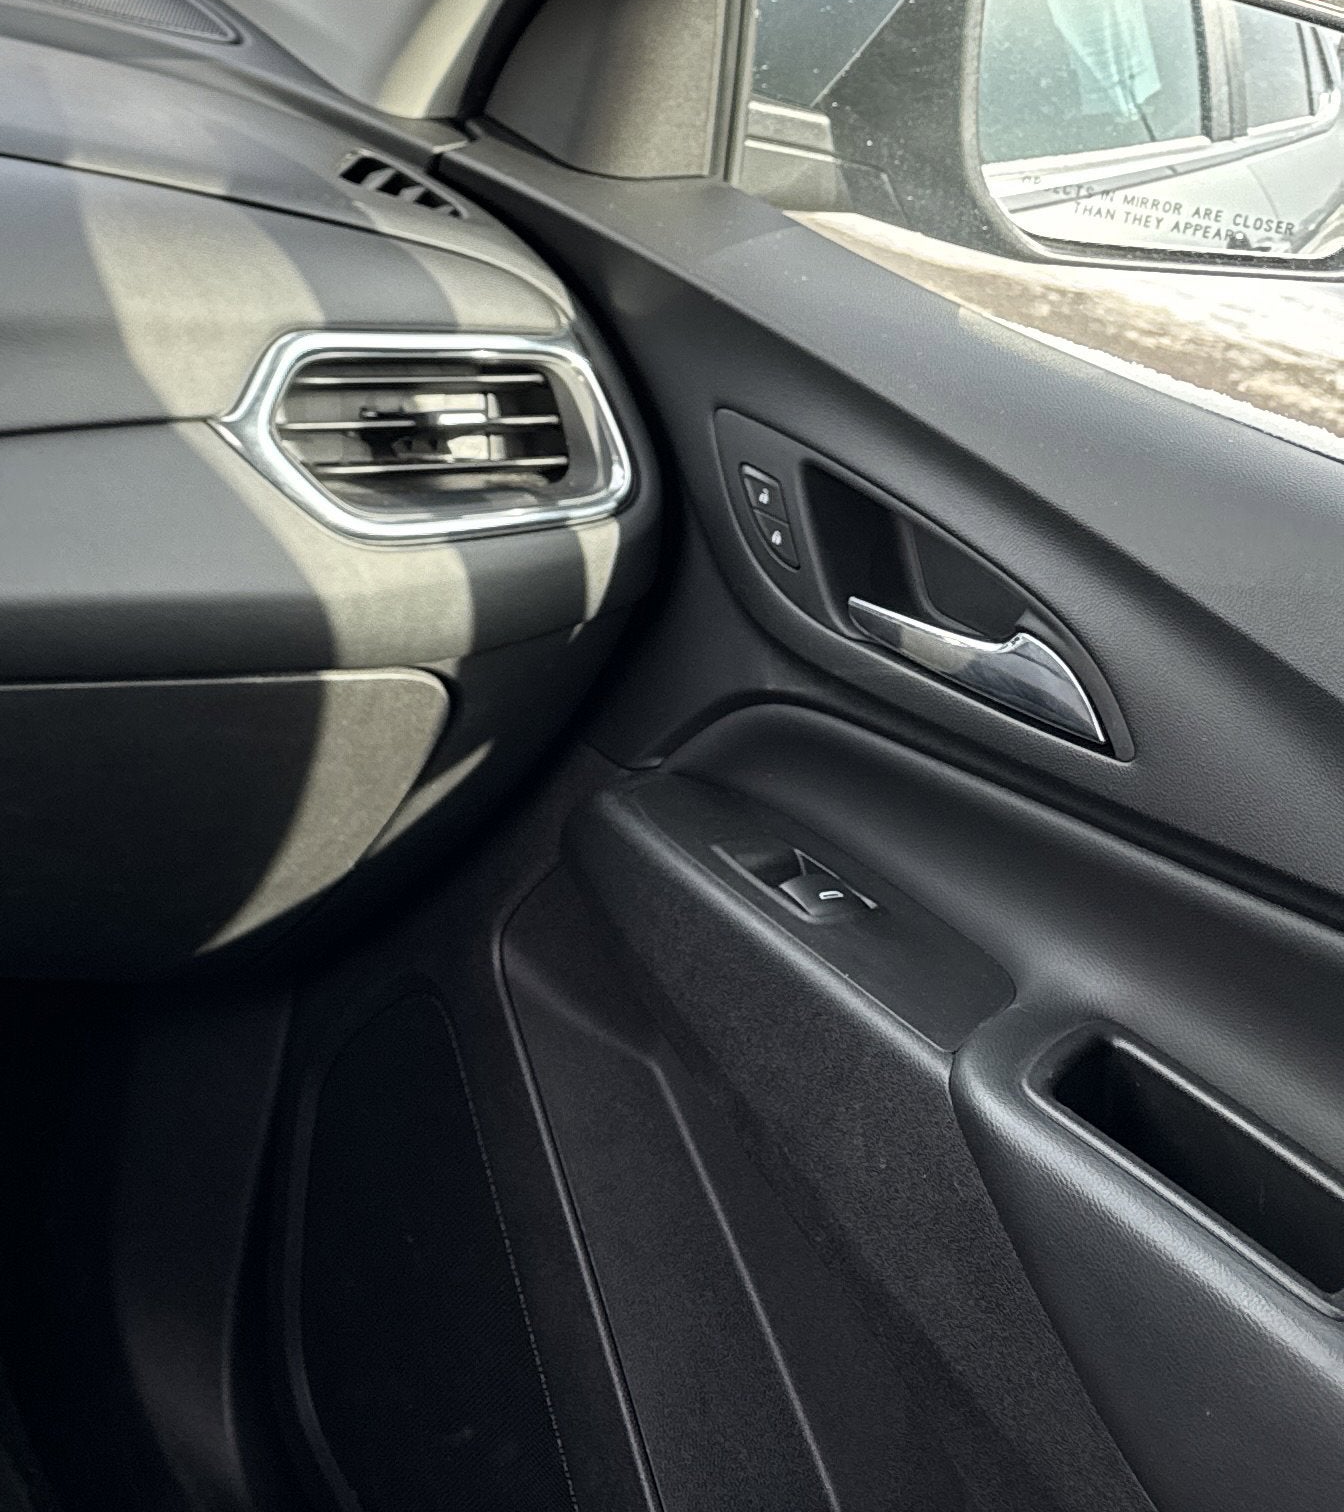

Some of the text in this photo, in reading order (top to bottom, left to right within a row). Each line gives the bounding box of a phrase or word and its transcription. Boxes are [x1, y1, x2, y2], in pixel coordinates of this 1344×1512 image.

[1074, 201, 1240, 242] THAN THEY APPEAR
[1123, 194, 1182, 215] MIRROR
[1194, 206, 1223, 222] ARE
[1232, 213, 1295, 236] CLOSER
